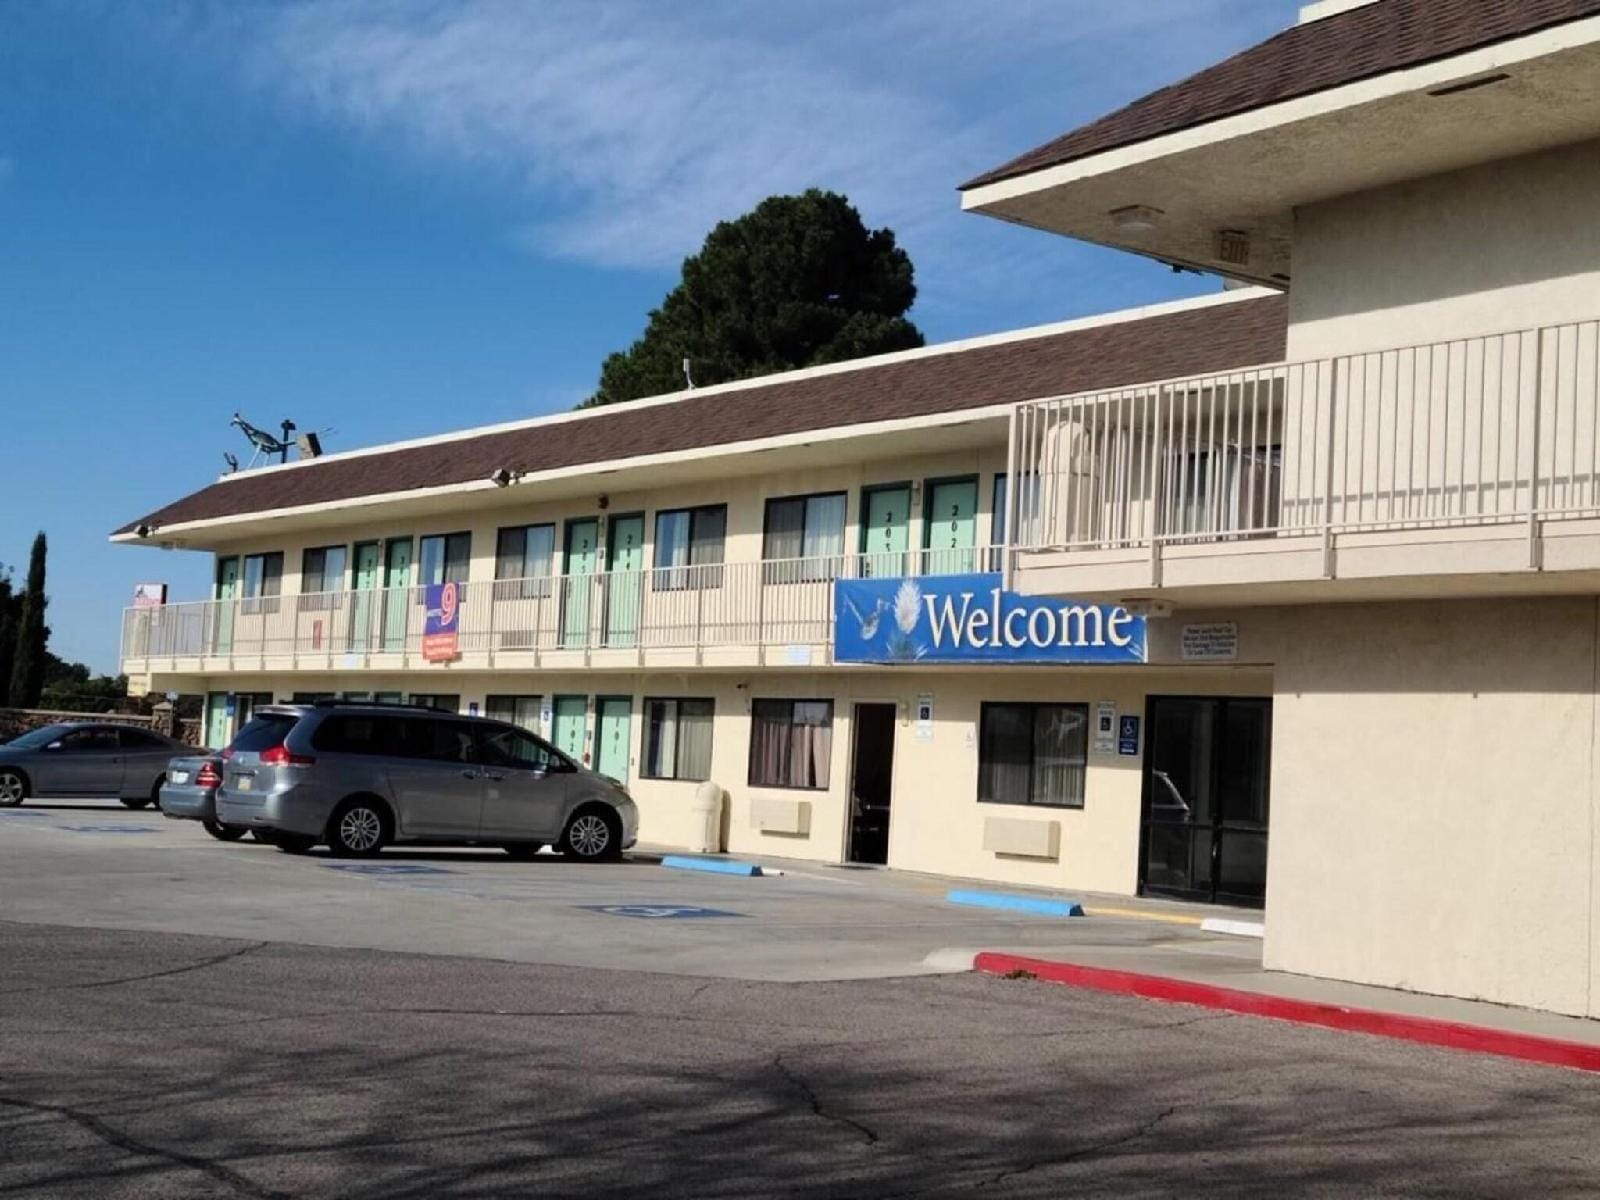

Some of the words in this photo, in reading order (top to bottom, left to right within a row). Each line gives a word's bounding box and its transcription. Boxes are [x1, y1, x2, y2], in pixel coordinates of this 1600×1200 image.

[951, 504, 959, 548] 202
[441, 582, 457, 626] 9
[923, 588, 1133, 648] Welcome
